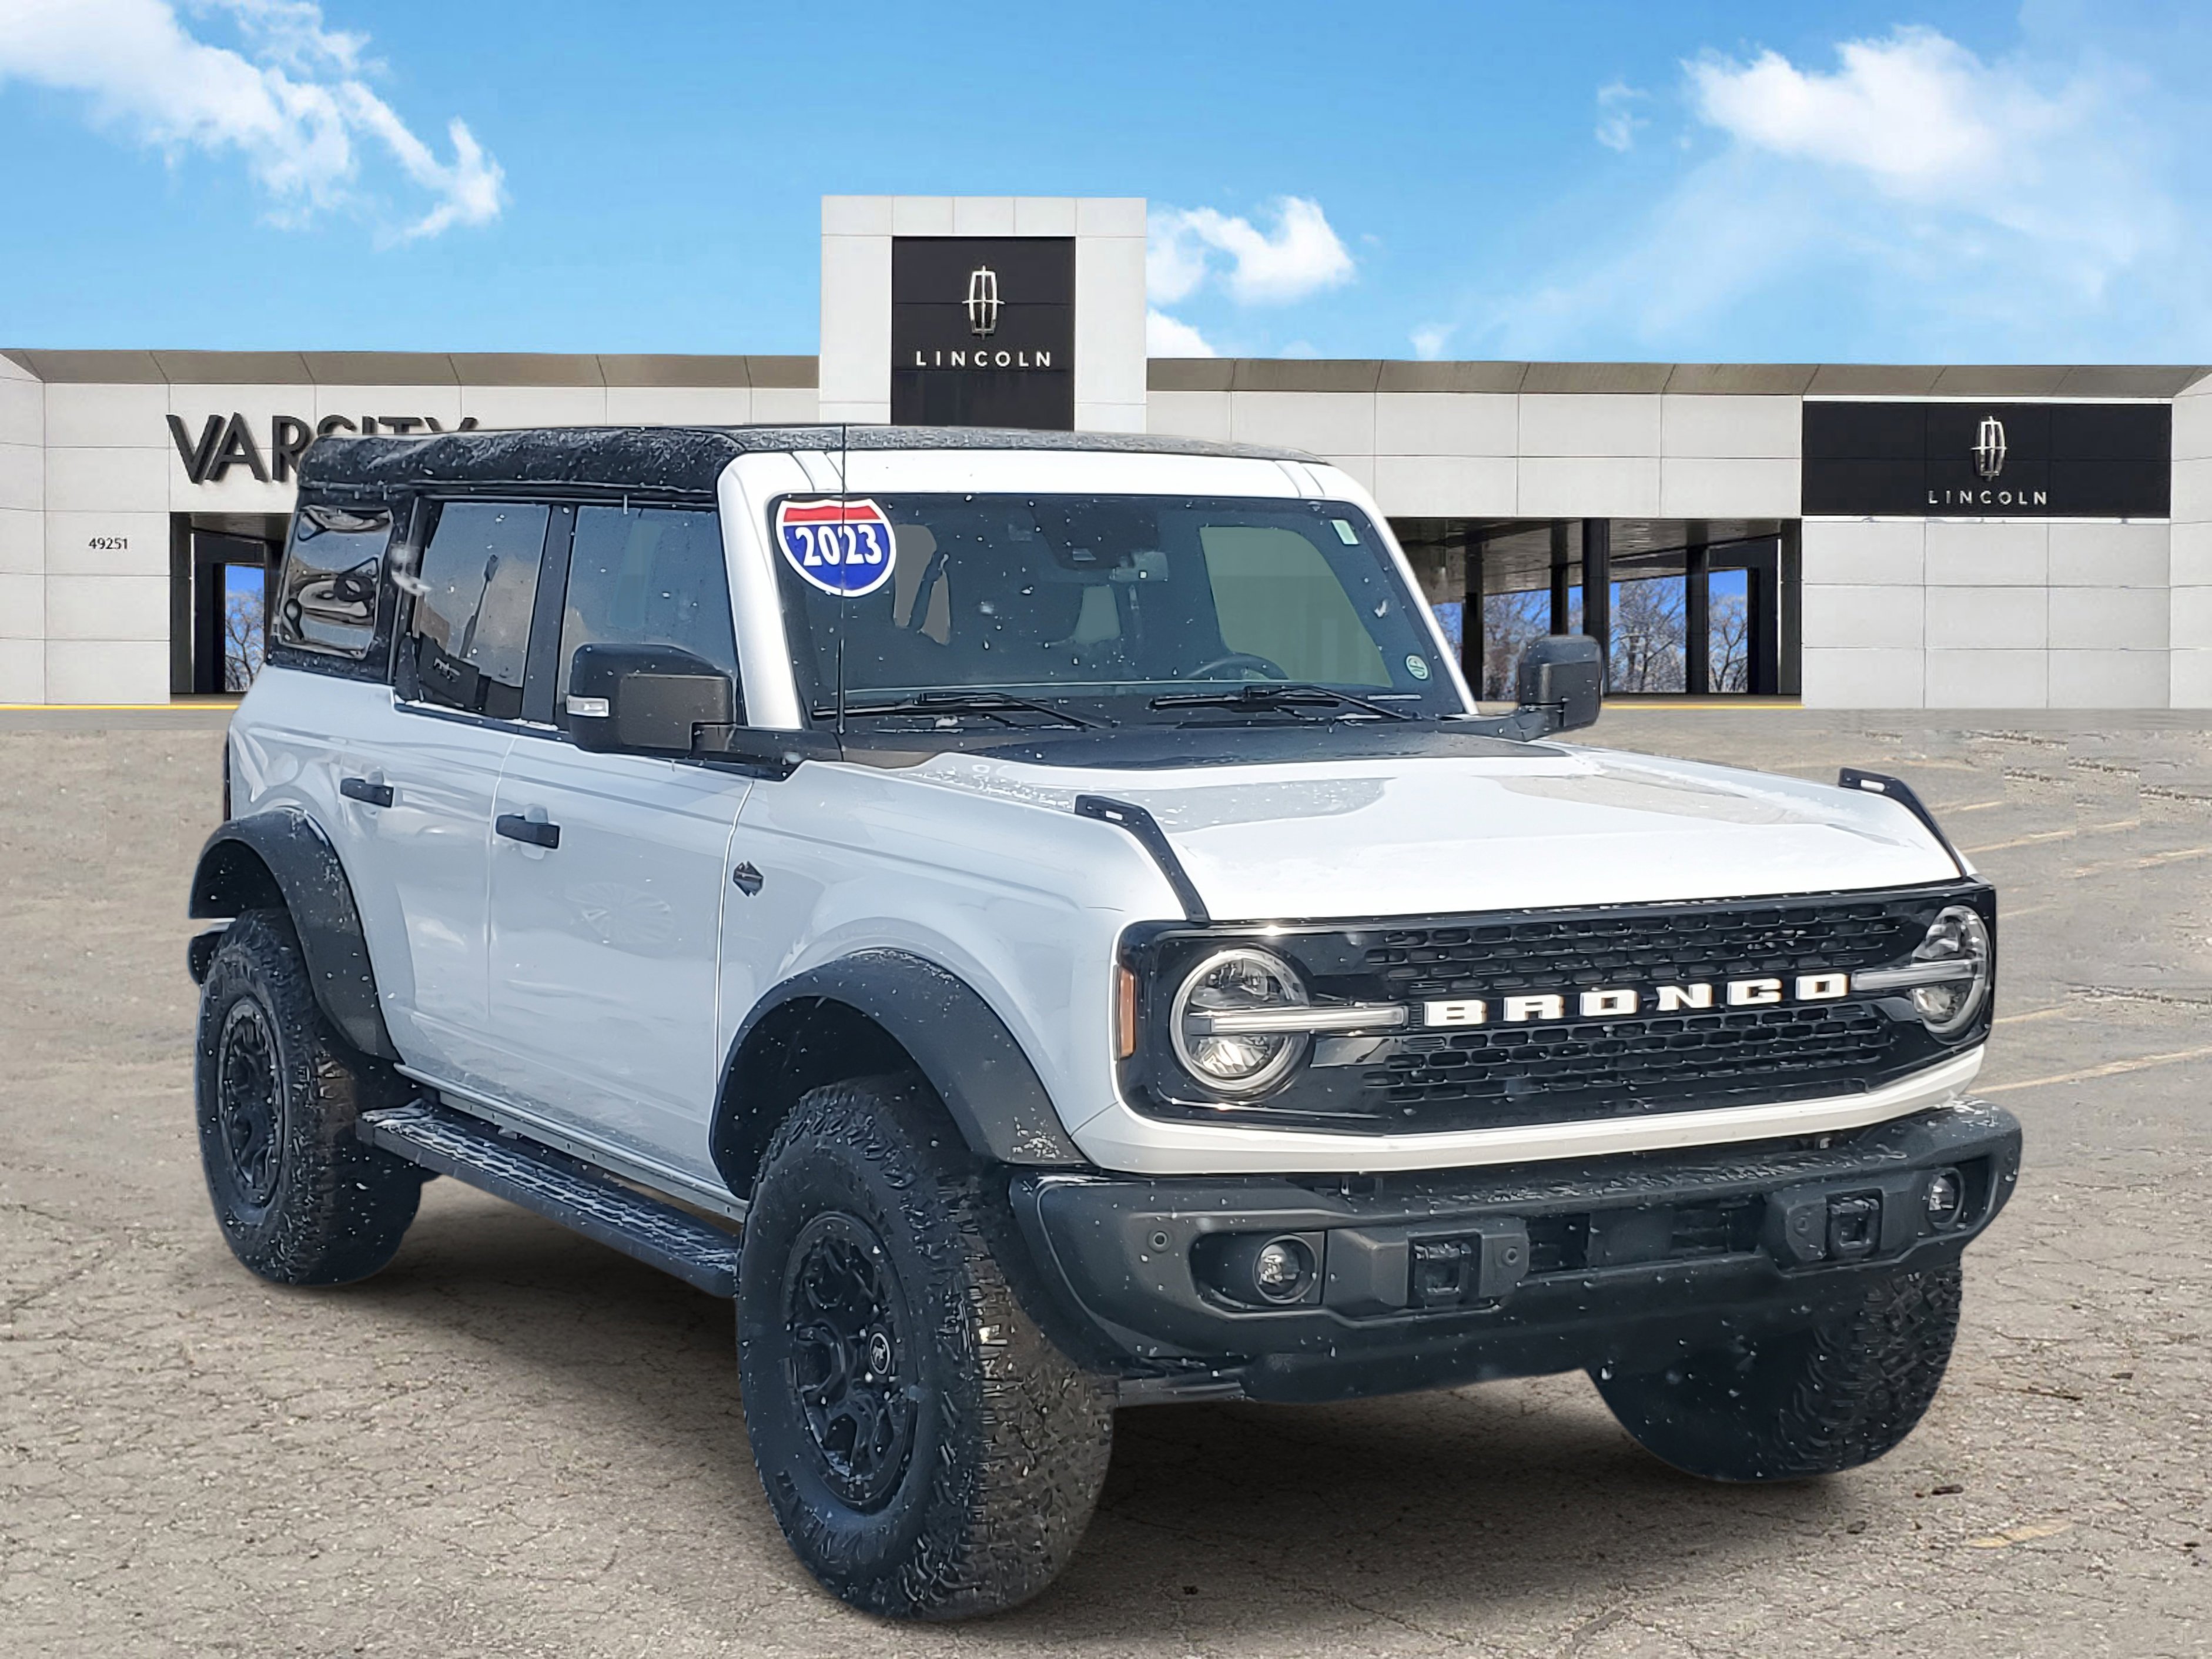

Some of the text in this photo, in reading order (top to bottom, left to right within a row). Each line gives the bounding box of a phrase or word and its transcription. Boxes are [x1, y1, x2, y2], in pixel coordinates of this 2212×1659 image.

[916, 351, 1051, 367] LINCOLN
[1928, 490, 2047, 506] LINCOLN
[88, 537, 128, 550] 49251
[795, 524, 882, 566] 2023
[1424, 973, 1848, 1026] BRONCO
